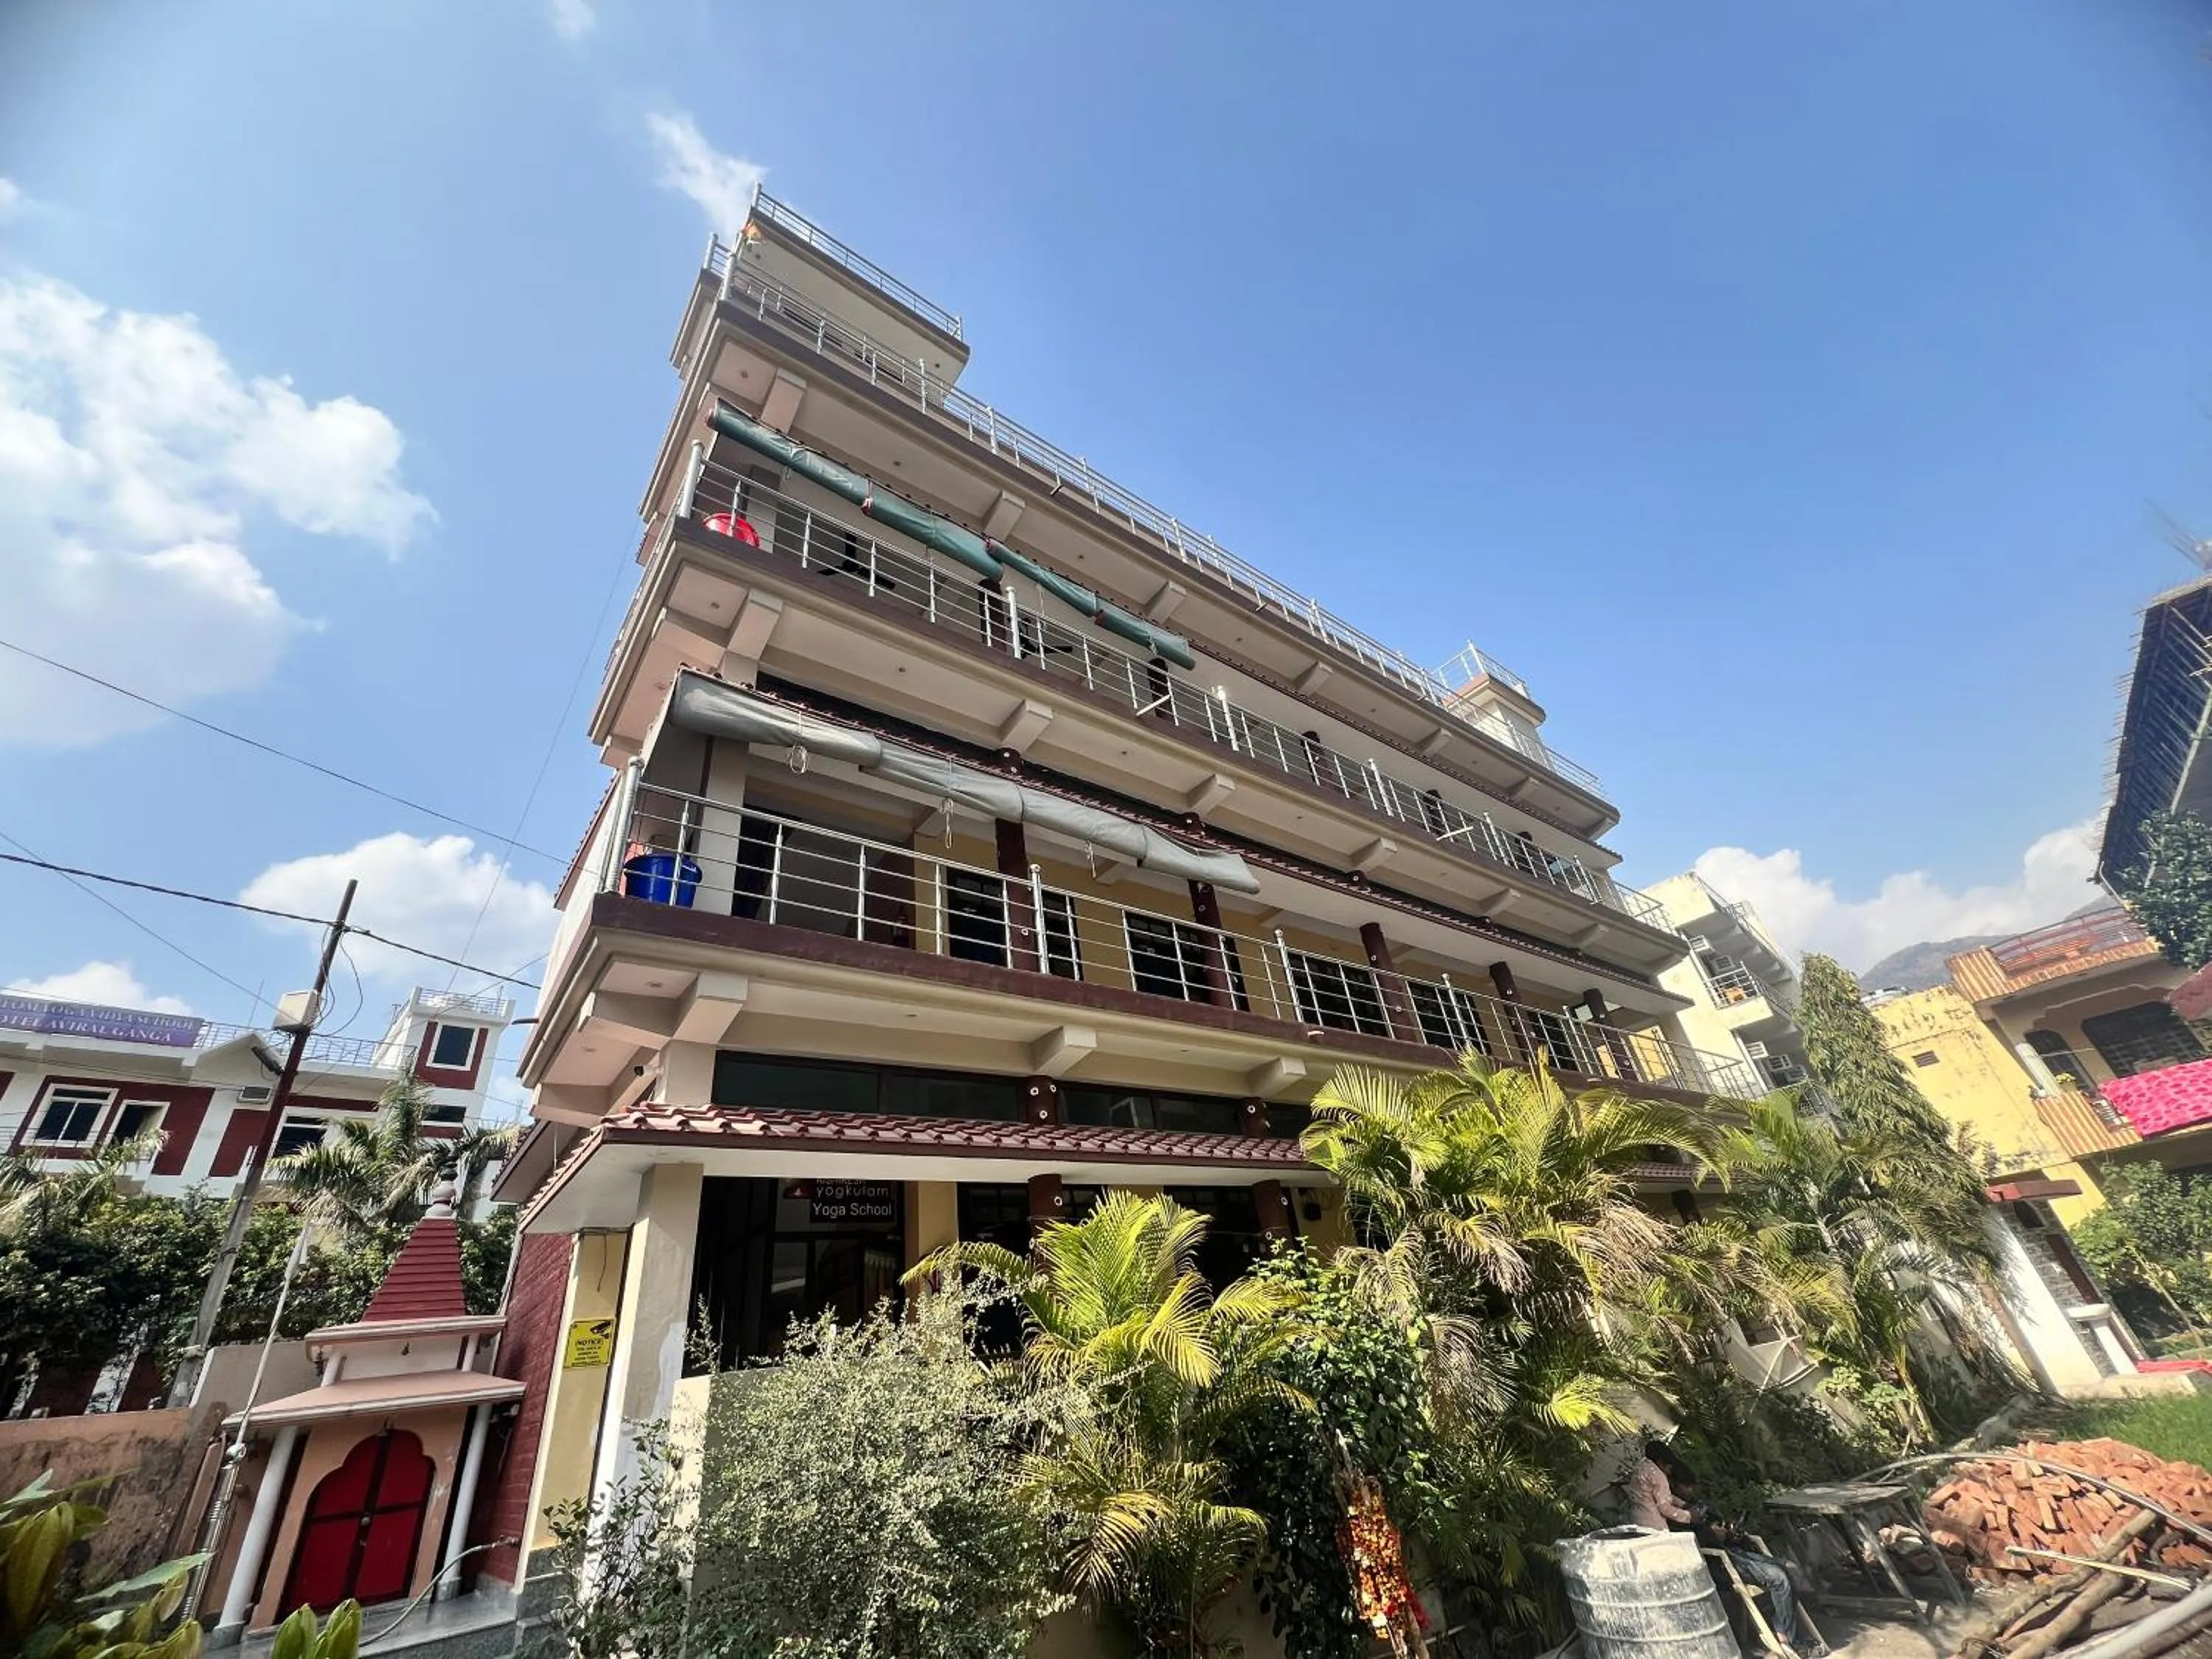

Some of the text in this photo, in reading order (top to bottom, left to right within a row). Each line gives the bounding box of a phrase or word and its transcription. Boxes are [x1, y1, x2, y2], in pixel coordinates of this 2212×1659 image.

[112, 1027, 171, 1042] GANGA
[816, 1185, 889, 1199] yogkulam
[813, 1203, 892, 1219] Yoga School
